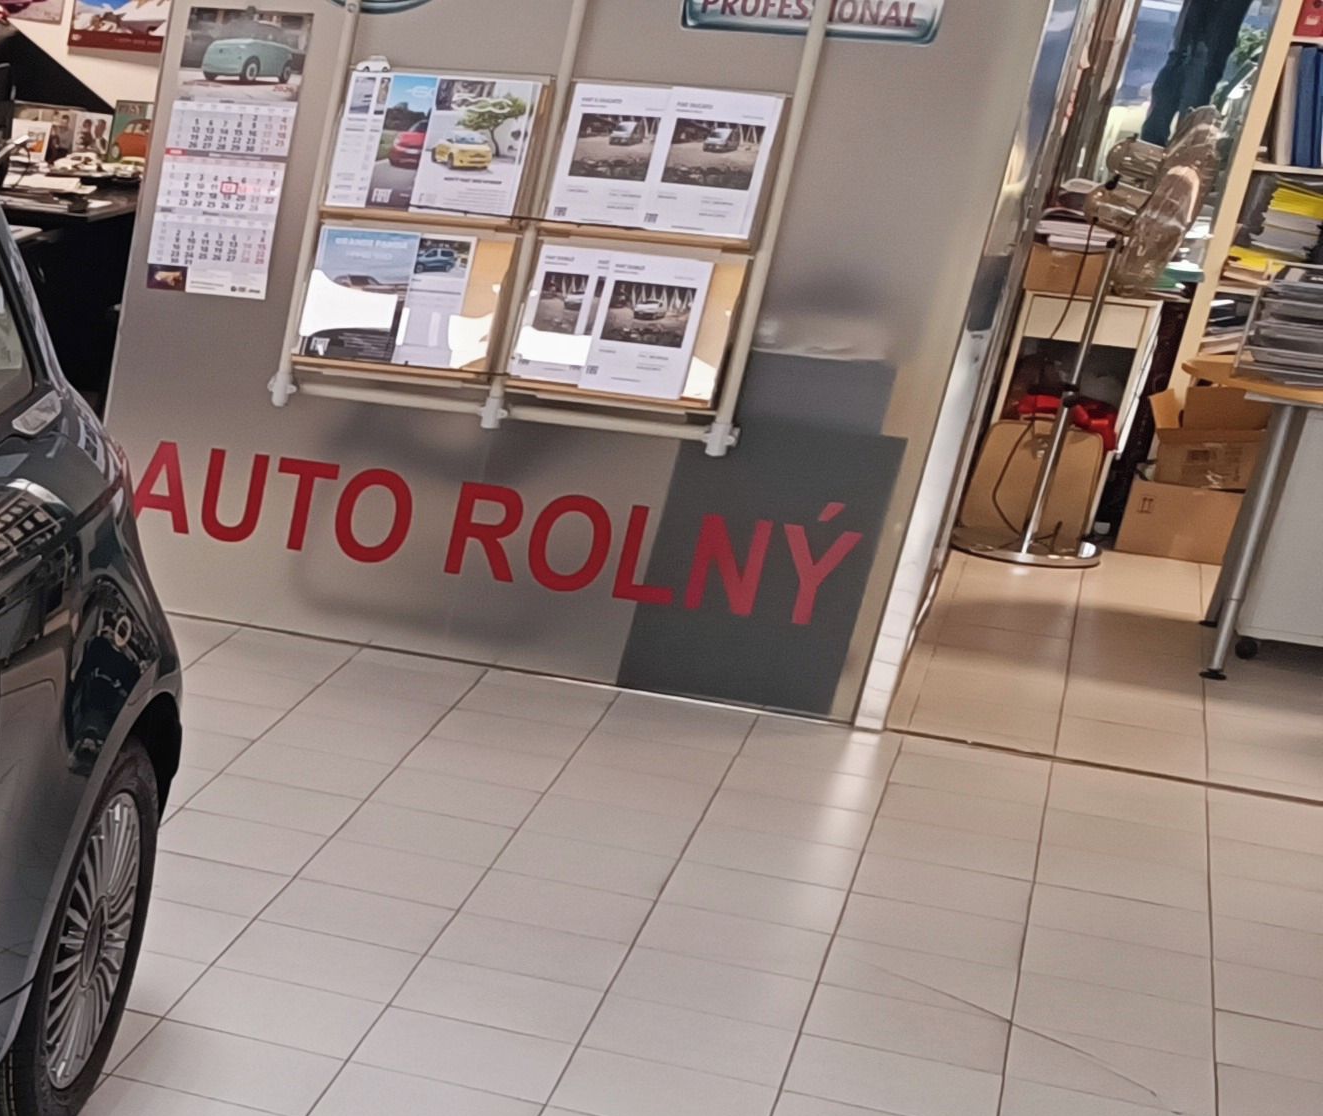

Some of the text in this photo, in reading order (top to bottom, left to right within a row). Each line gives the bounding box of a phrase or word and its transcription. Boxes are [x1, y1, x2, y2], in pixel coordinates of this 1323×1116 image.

[701, 0, 918, 28] PROFESIONAL
[132, 440, 863, 625] AUTO ROLNÝ
